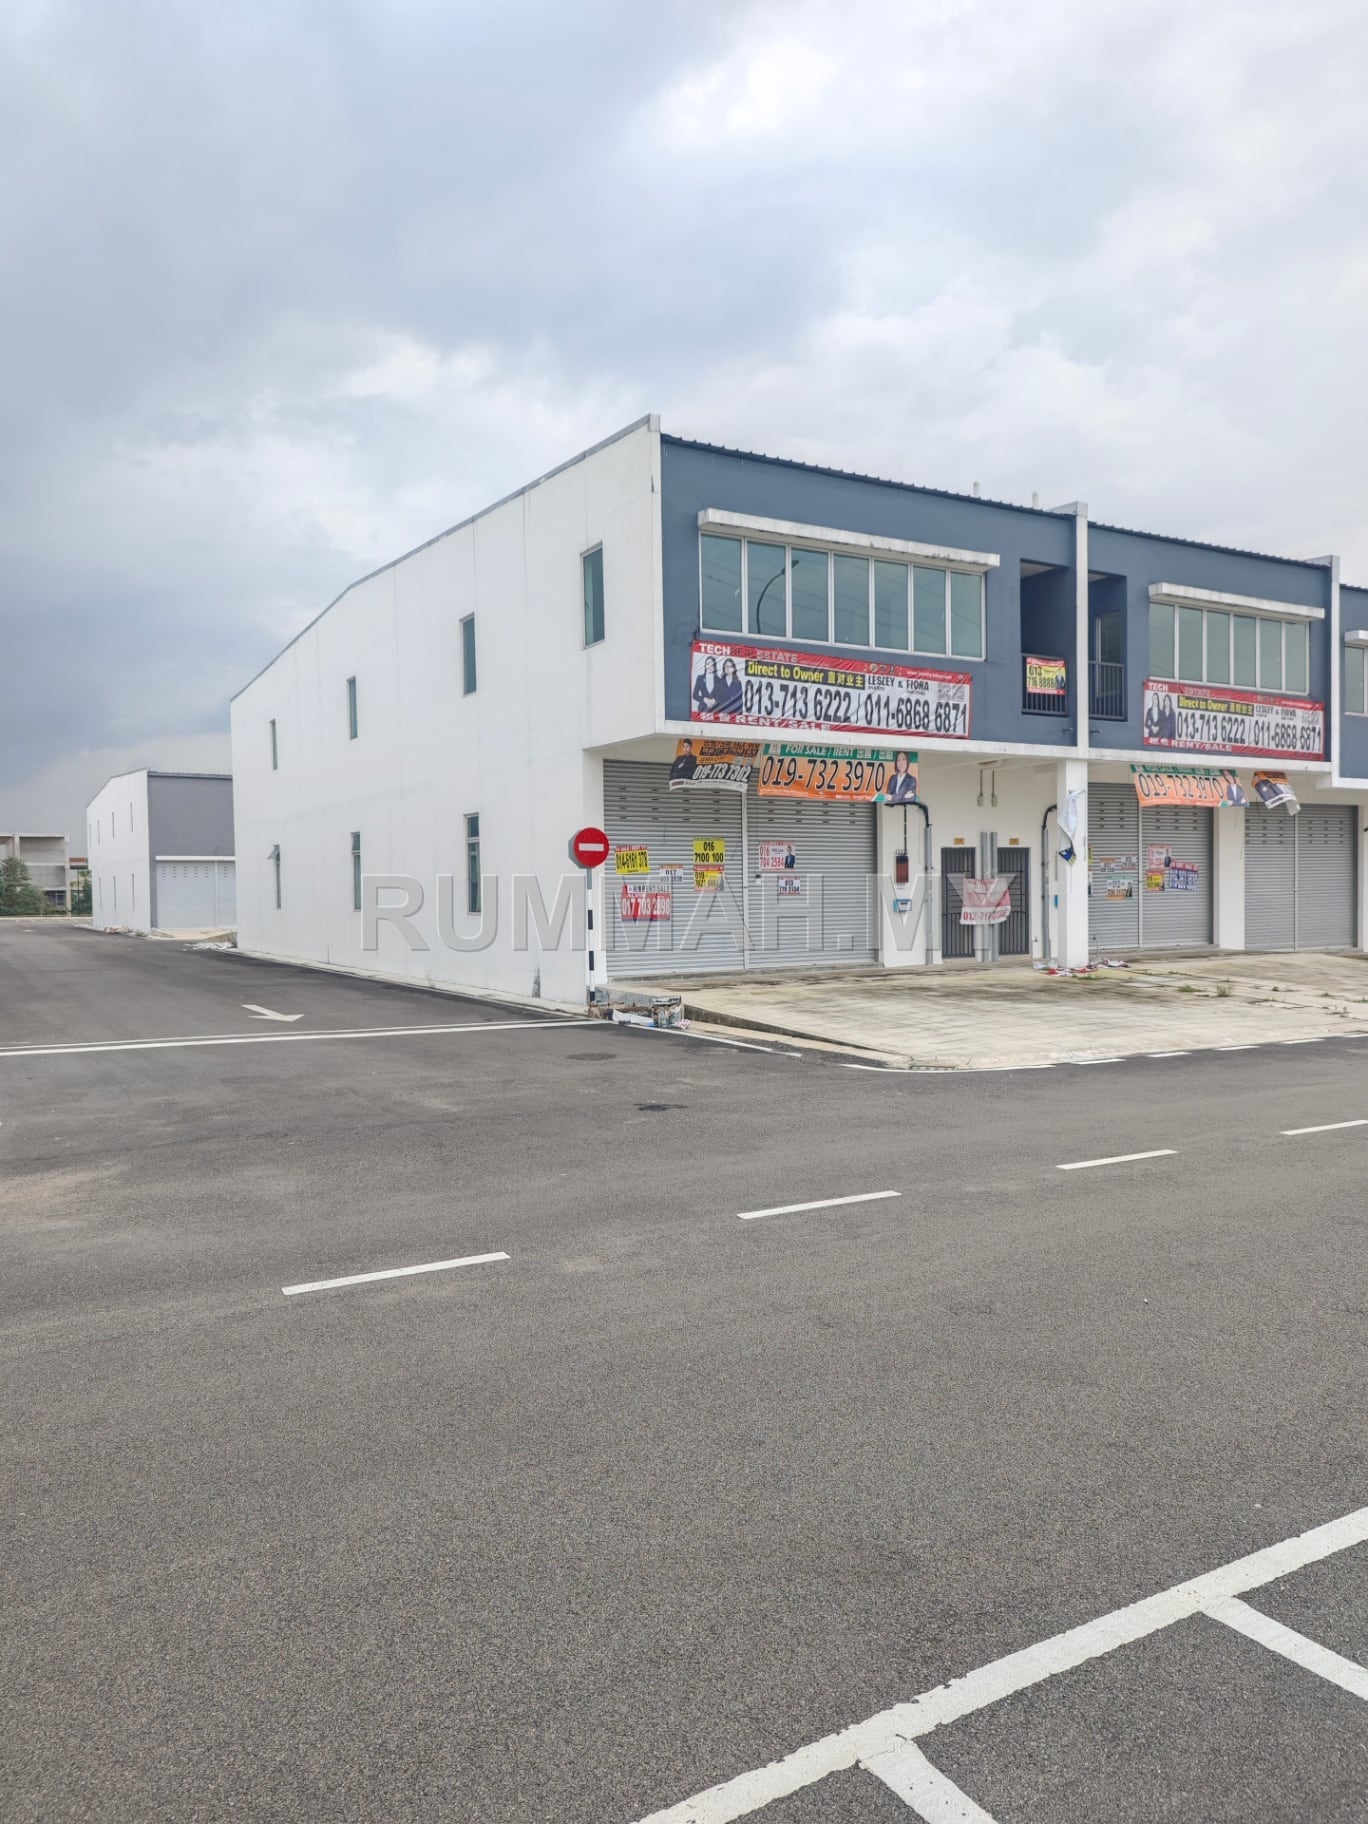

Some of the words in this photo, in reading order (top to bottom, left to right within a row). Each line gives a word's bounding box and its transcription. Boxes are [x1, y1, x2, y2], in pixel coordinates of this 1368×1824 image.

[699, 642, 731, 656] TECH
[757, 649, 799, 663] ESTATE
[747, 661, 778, 678] Direct
[780, 666, 791, 679] to
[793, 667, 825, 683] Owner
[868, 675, 895, 688] LESLEY
[906, 679, 930, 692] FIONA
[1148, 682, 1169, 692] TECH
[744, 679, 808, 720] 013-713
[813, 687, 852, 724] 6222
[864, 693, 931, 731] 011-6868
[934, 701, 968, 735] 6871
[1179, 696, 1199, 709] Direct
[1207, 700, 1228, 711] Owner
[735, 713, 832, 731] RENT/SALE
[1177, 711, 1218, 742] 013-713
[1220, 716, 1246, 744] 6222
[1253, 719, 1298, 750] 011-6868
[1299, 726, 1322, 752] 6871
[785, 744, 803, 755] FOR
[804, 745, 827, 756] SALE
[834, 747, 855, 758] RENT
[1171, 737, 1233, 752] RENT/SALE
[692, 763, 728, 780] 019-773
[761, 755, 839, 791] 019-732
[842, 760, 886, 793] 3970
[1138, 773, 1195, 798] 019-732
[1192, 775, 1225, 800] 3970
[703, 841, 715, 852] 016
